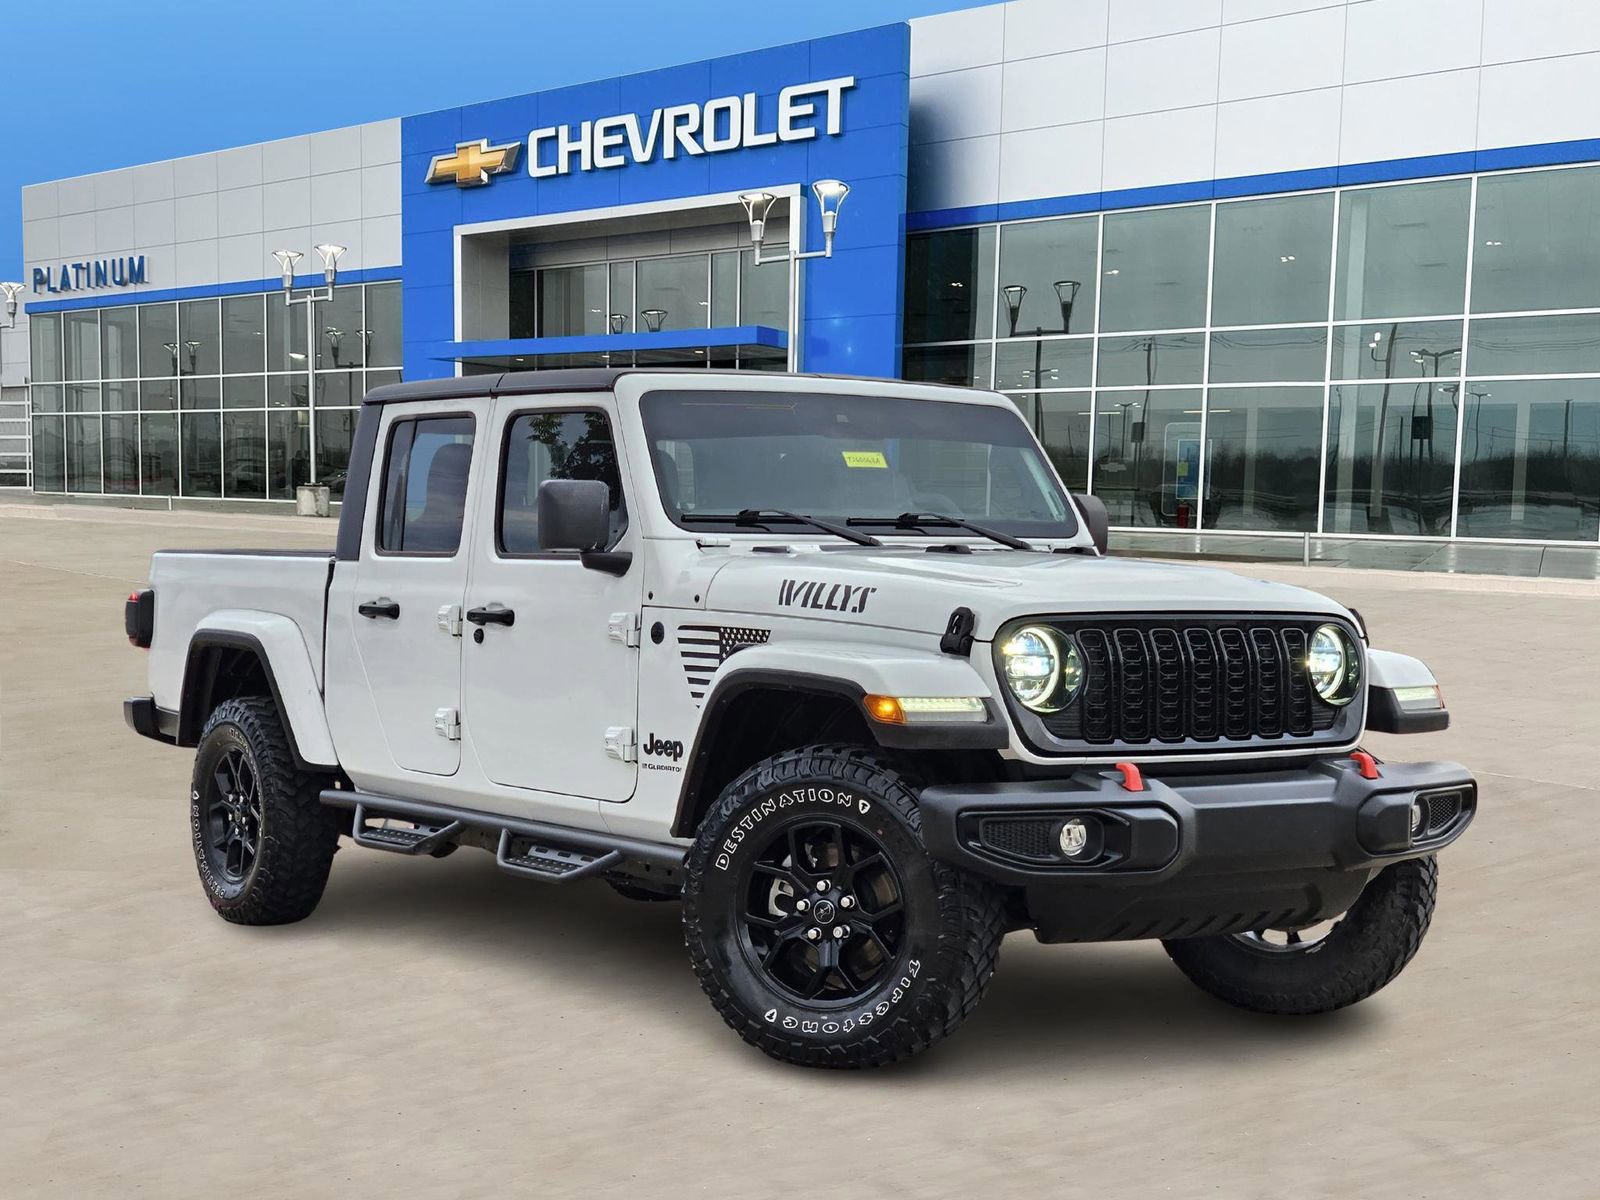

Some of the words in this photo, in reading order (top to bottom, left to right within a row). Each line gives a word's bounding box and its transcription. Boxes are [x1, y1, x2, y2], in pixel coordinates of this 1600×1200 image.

[527, 76, 855, 178] CHEVROLET
[33, 255, 145, 293] PLATINUM
[778, 579, 877, 613] WILLYS
[643, 732, 684, 762] Jeep
[715, 788, 852, 871] DESTINATION
